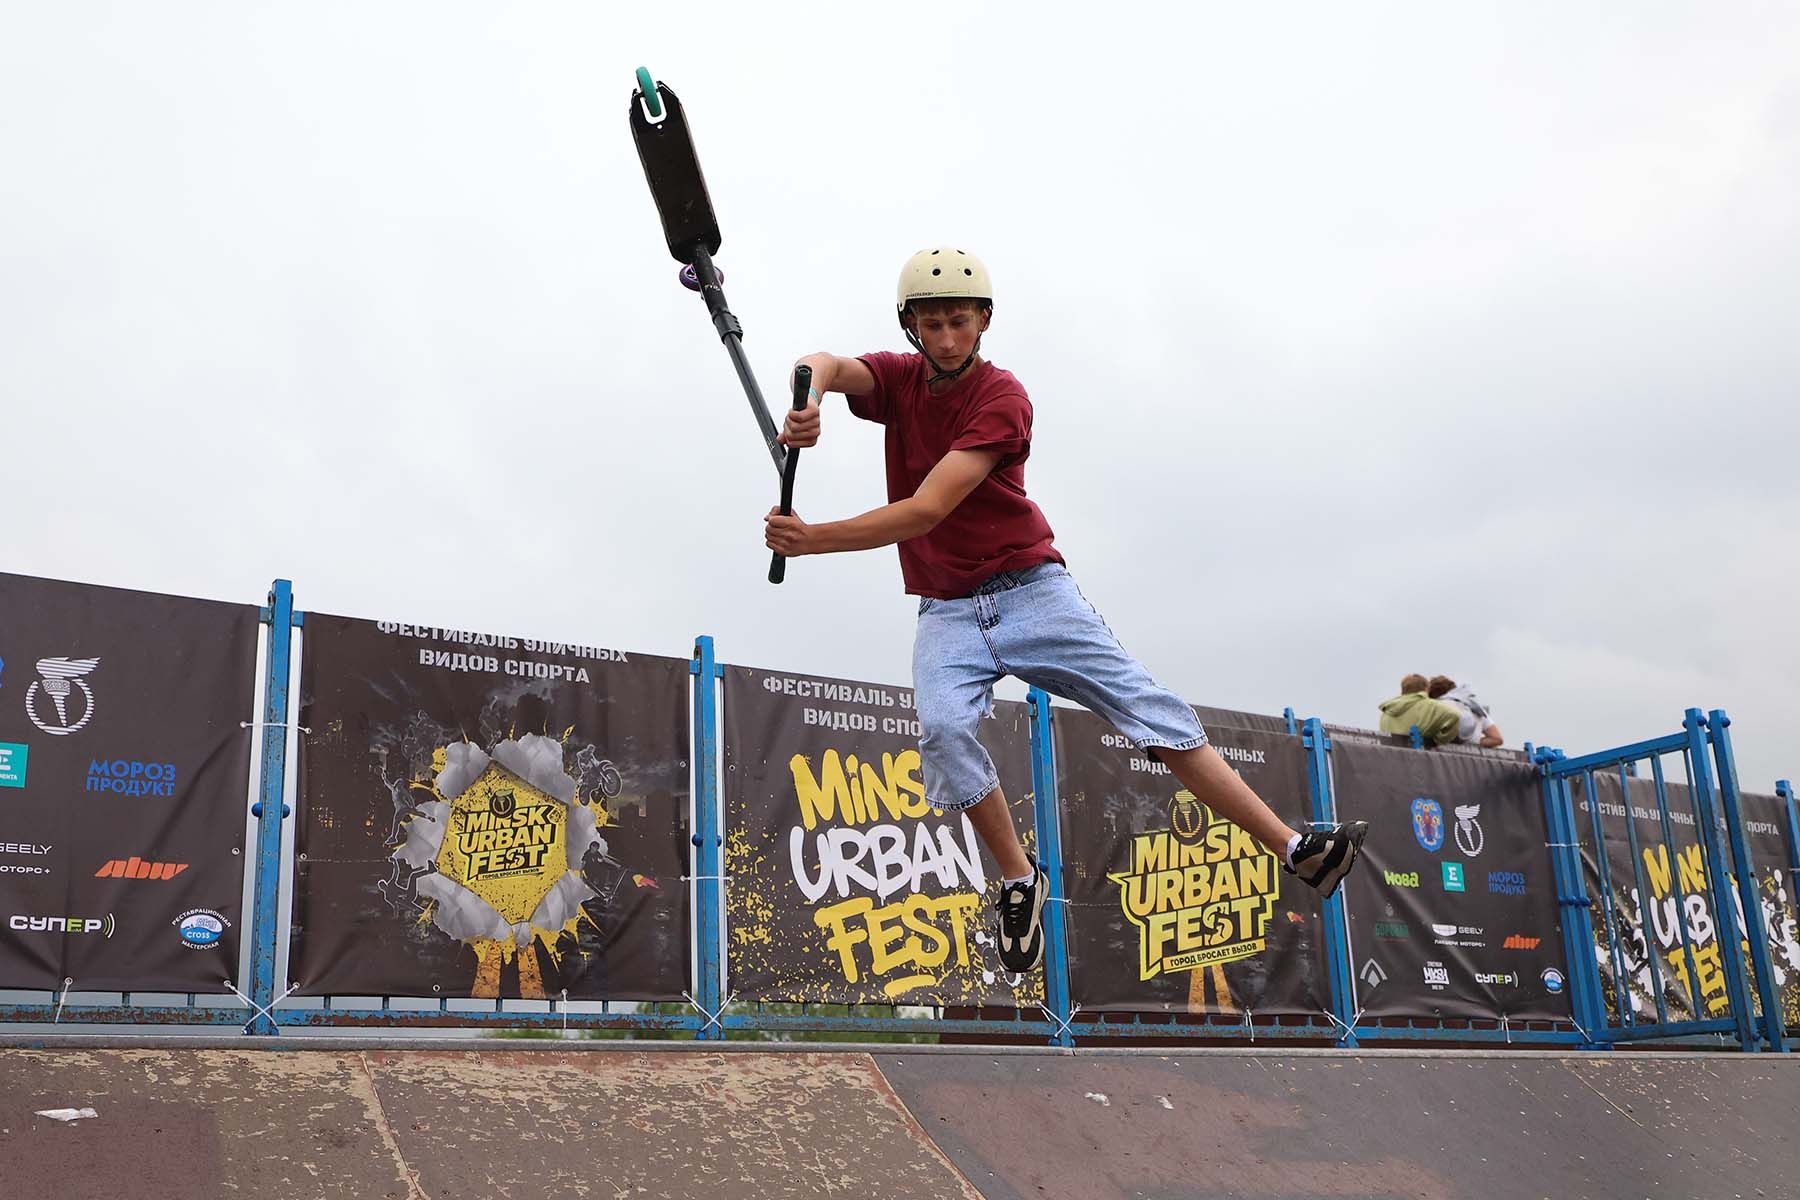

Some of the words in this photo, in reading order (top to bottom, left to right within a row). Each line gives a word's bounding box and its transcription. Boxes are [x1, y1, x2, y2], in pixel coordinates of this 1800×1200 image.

[377, 621, 518, 650] ФЕСТИВАЛЬ
[523, 638, 629, 663] УЛИЧНЫХ
[419, 648, 499, 673] ВИДОВ
[504, 659, 591, 684] СПОРТА
[763, 676, 895, 708] ФЕСТИВАЛЬ
[803, 708, 877, 732] ВИДОВ
[882, 717, 923, 737] СПО
[1130, 757, 1172, 775] ВИДО
[1213, 746, 1266, 763] ИЧНЫХ
[88, 759, 177, 781] МОРОЗ
[86, 776, 175, 796] ПРОДУКТ
[466, 806, 549, 833] MINSK
[1746, 821, 1779, 836] ПОРТА
[459, 824, 553, 854] URBAN
[1135, 823, 1261, 875] MINSK
[468, 845, 545, 880] FEST
[789, 813, 987, 906] URBAN
[1124, 855, 1270, 917] URBAN
[1488, 871, 1525, 884] МОРОЗ
[1488, 883, 1526, 896] ПРОДУКТ
[9, 915, 102, 933] СУПЕР
[1145, 896, 1263, 967] FEST
[1458, 926, 1484, 935] GEELY
[814, 894, 979, 984] FEST
[1170, 955, 1197, 967] ГОРОД
[1197, 949, 1231, 962] БРОСАЕТ
[1232, 943, 1257, 954] ВЫЗОВ
[1475, 973, 1513, 985] СУПЕР
